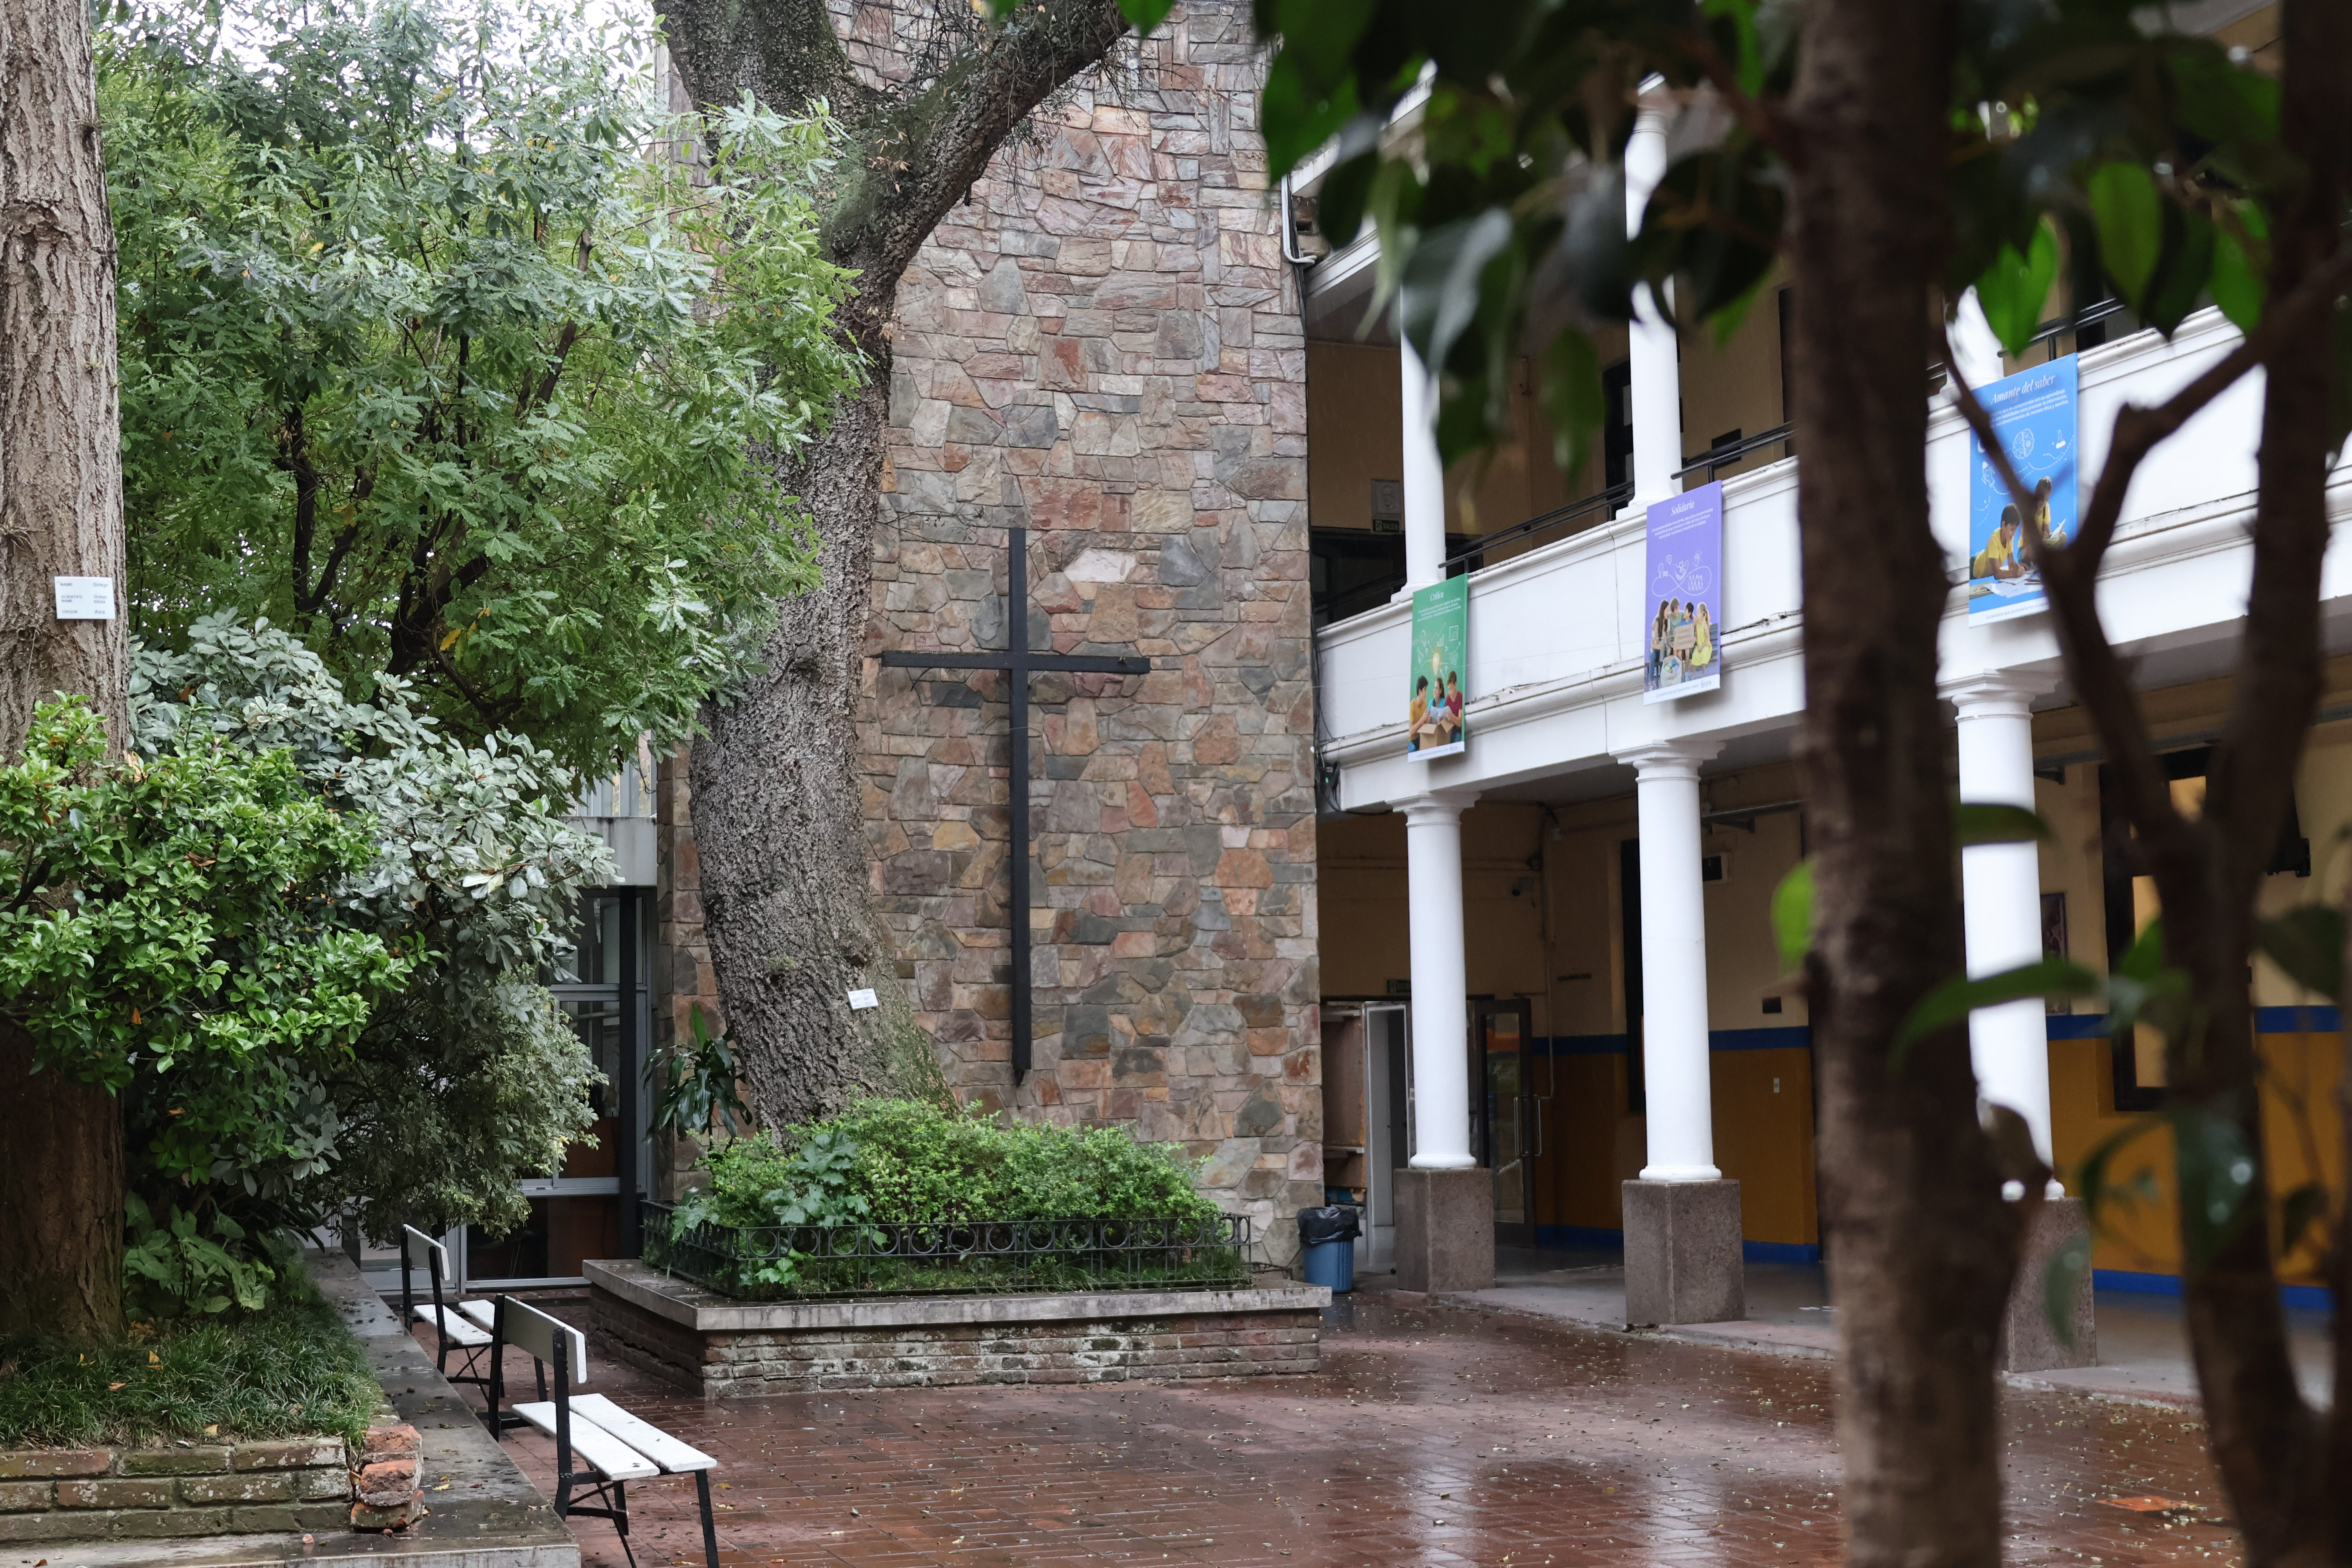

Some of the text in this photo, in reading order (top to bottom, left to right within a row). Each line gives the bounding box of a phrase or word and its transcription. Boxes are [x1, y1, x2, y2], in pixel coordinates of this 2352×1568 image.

[1991, 375, 2056, 405] Amante del saber
[1671, 499, 1695, 516] Solidaria
